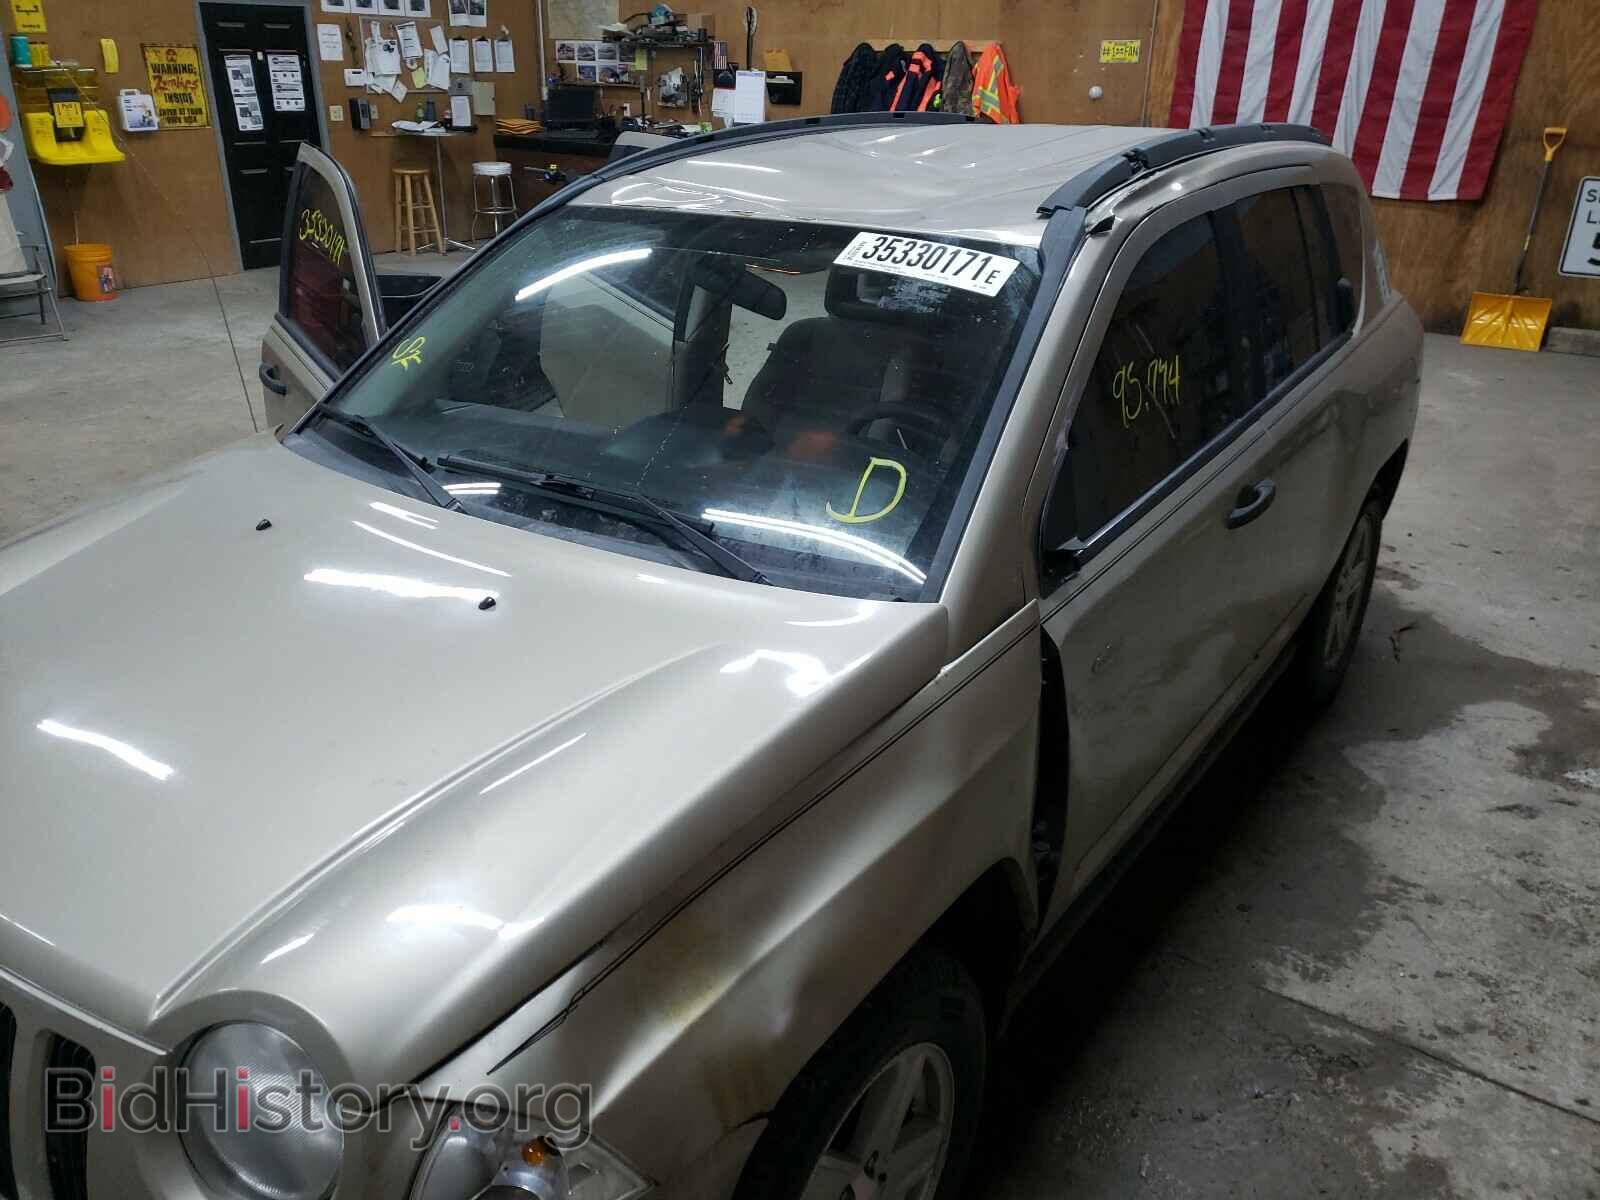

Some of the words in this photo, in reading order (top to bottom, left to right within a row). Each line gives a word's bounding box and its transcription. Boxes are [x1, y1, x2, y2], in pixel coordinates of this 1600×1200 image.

[164, 92, 194, 104] INSIDE
[861, 236, 993, 281] 35330171
[984, 269, 1001, 285] E
[825, 456, 907, 525] D
